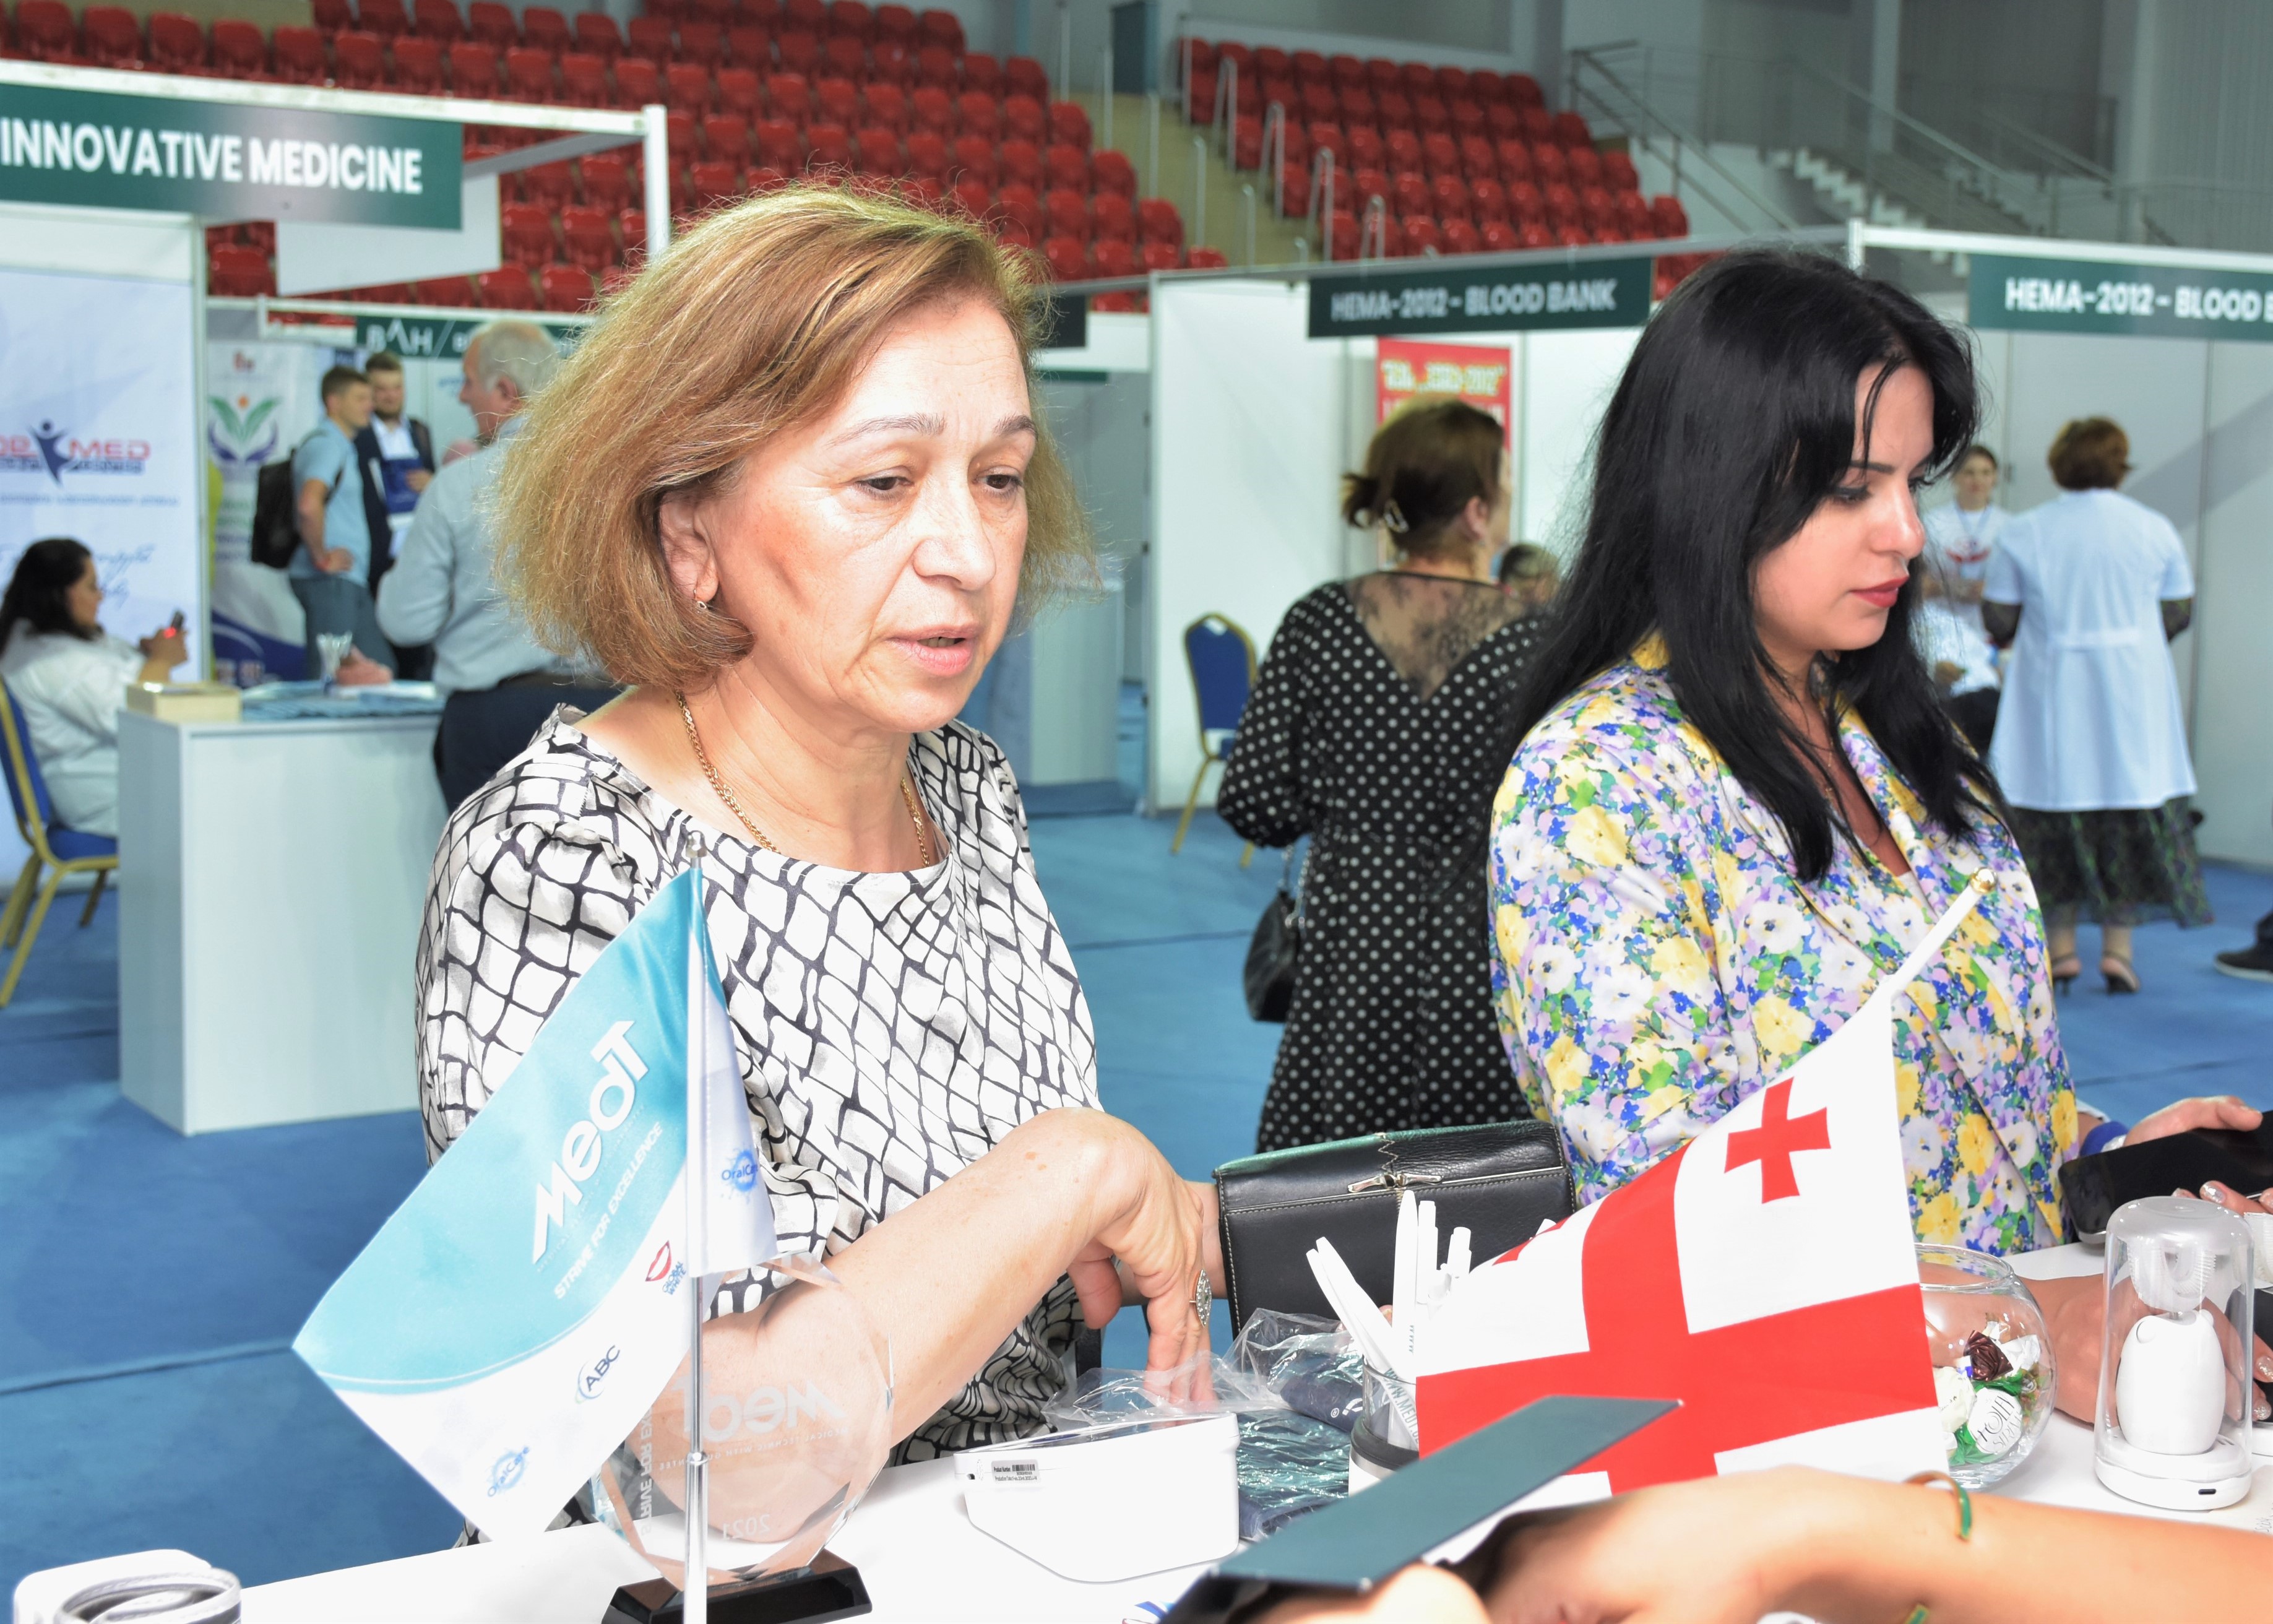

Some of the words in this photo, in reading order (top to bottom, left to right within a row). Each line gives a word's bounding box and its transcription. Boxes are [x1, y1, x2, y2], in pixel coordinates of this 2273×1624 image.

[0, 116, 244, 183] INNOVATIVE
[249, 137, 424, 195] MEDICINE
[1331, 286, 1449, 322] HEMA-2012
[1464, 283, 1545, 316] BLOOD
[1546, 278, 1618, 313] BANK
[2004, 277, 2155, 316] HEMA-2012
[2175, 285, 2262, 321] BLOOD
[69, 438, 150, 461] MED
[554, 1243, 594, 1300] STRIVE
[590, 1212, 611, 1248] FOR
[607, 1121, 664, 1216] EXCELLENCE
[586, 1344, 621, 1393] ABC
[487, 1446, 530, 1497] OralCare
